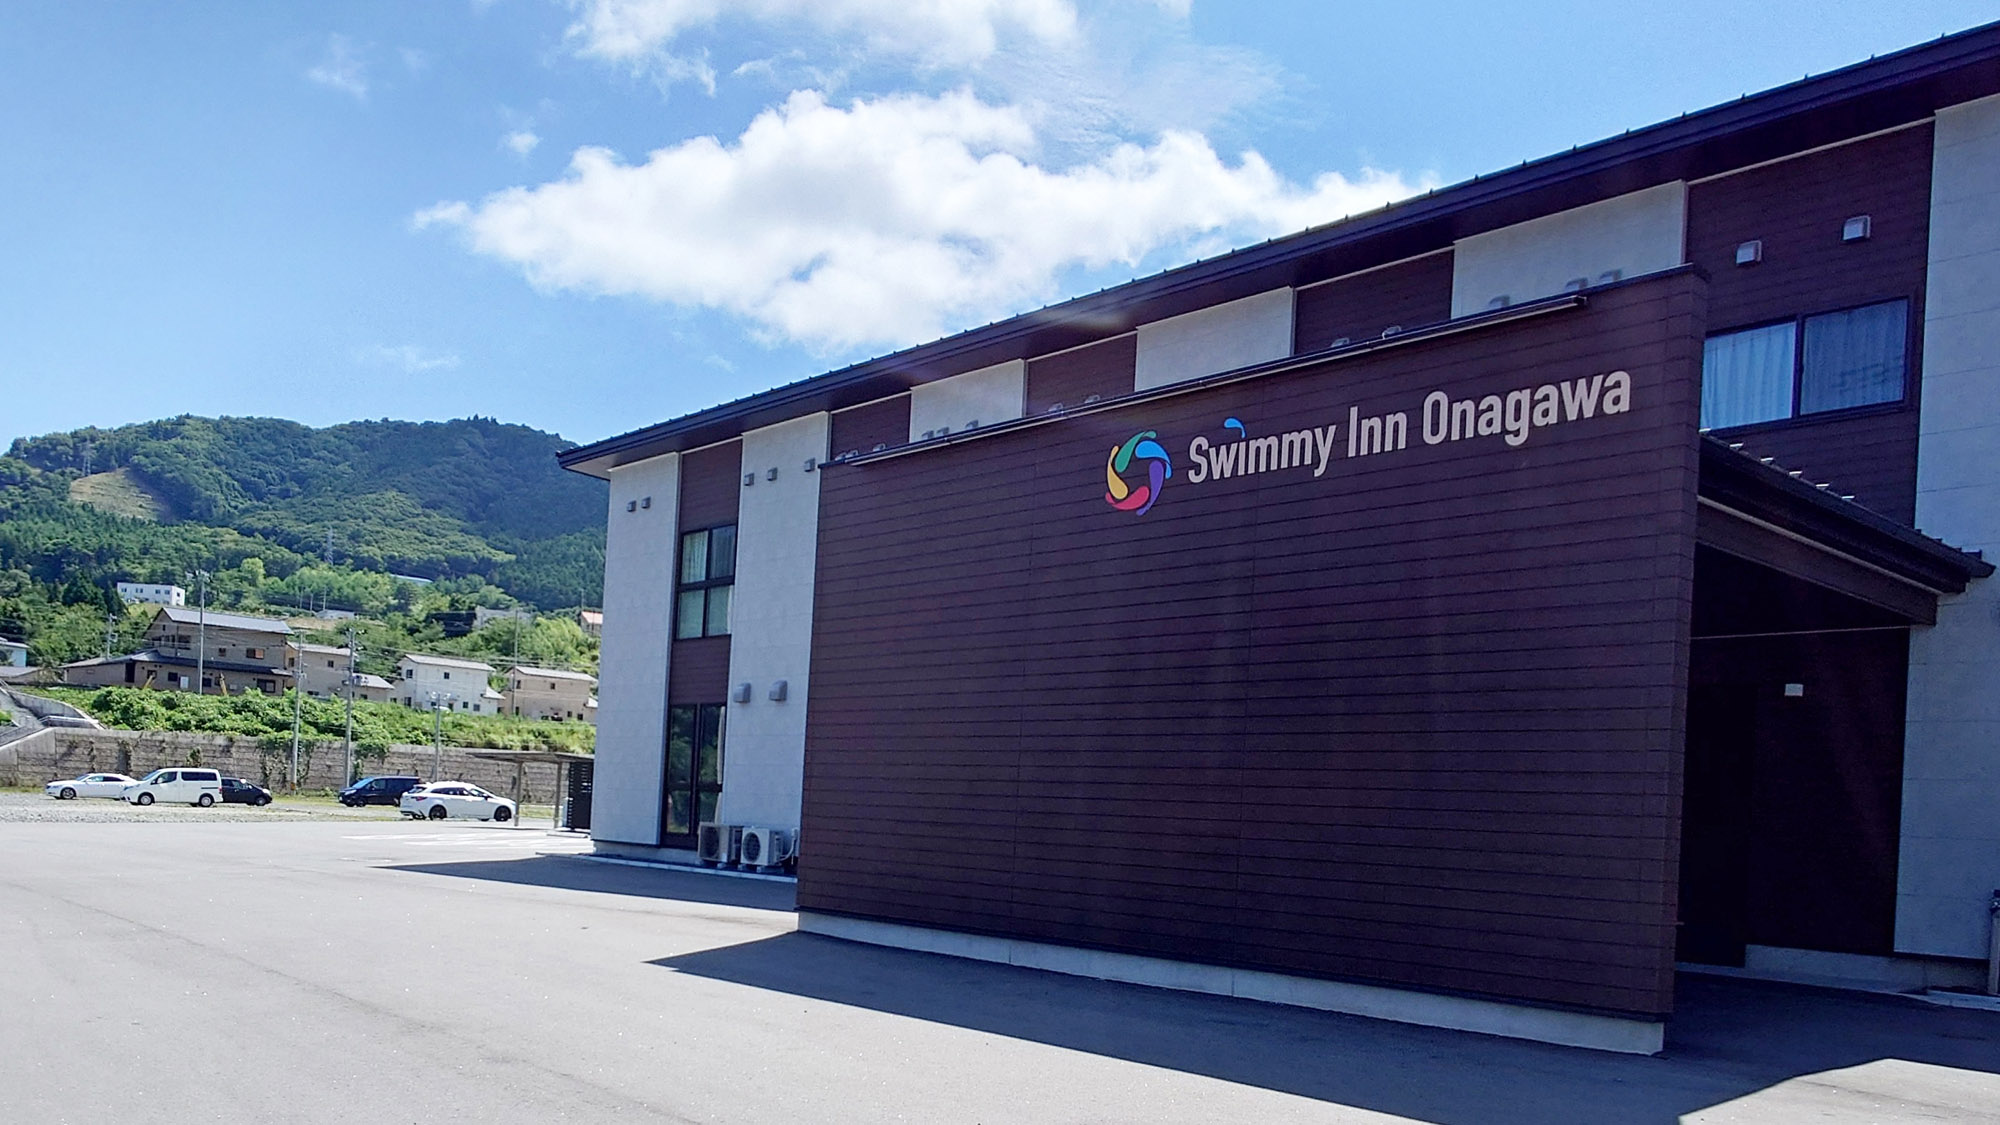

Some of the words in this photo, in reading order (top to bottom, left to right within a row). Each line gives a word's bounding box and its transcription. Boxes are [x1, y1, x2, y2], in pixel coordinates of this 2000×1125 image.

[1188, 419, 1337, 483] Swimmy
[1347, 406, 1407, 458] Inn
[1422, 370, 1631, 446] Onagawa
